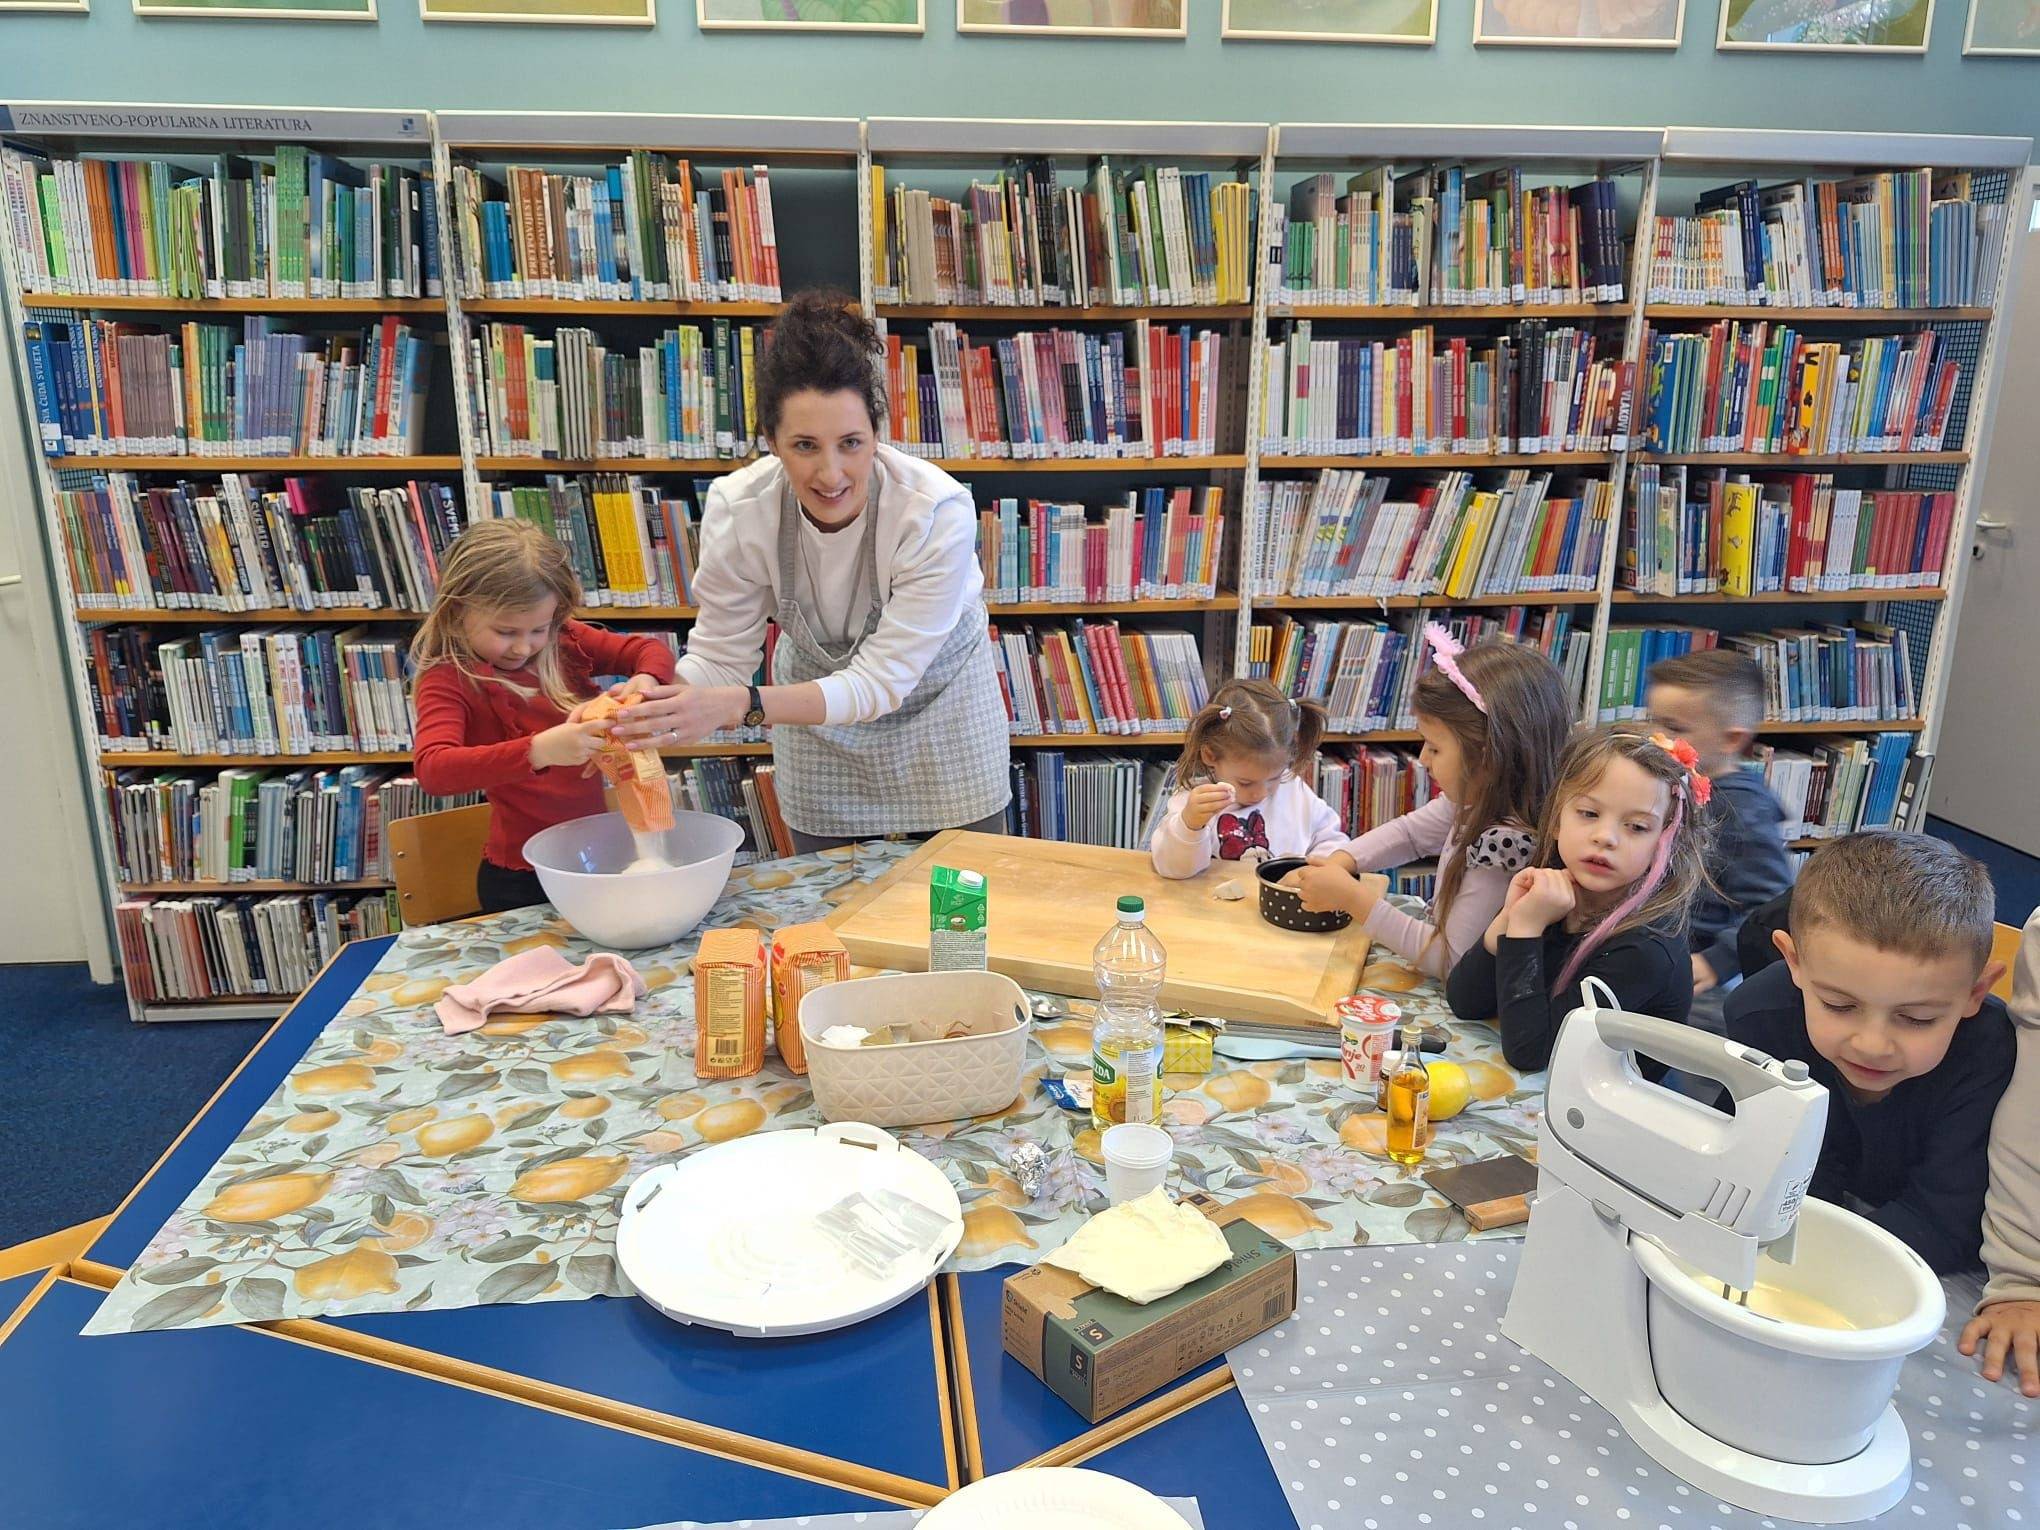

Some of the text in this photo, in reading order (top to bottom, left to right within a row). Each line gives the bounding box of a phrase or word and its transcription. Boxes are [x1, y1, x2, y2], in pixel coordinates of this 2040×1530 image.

[18, 111, 313, 132] ZNANSTVENO-POPULARNA LITERATURA
[522, 197, 538, 274] PRETPOVIJEST
[534, 197, 550, 276] PRETPOVIJEST
[31, 344, 44, 380] SVIJETA
[37, 381, 49, 408] ČUDA
[1616, 388, 1632, 432] VLAKOVI
[249, 500, 270, 549] SVEMIR
[1222, 1248, 1262, 1272] Shield
[1089, 1327, 1104, 1341] S
[1074, 1354, 1084, 1371] S
